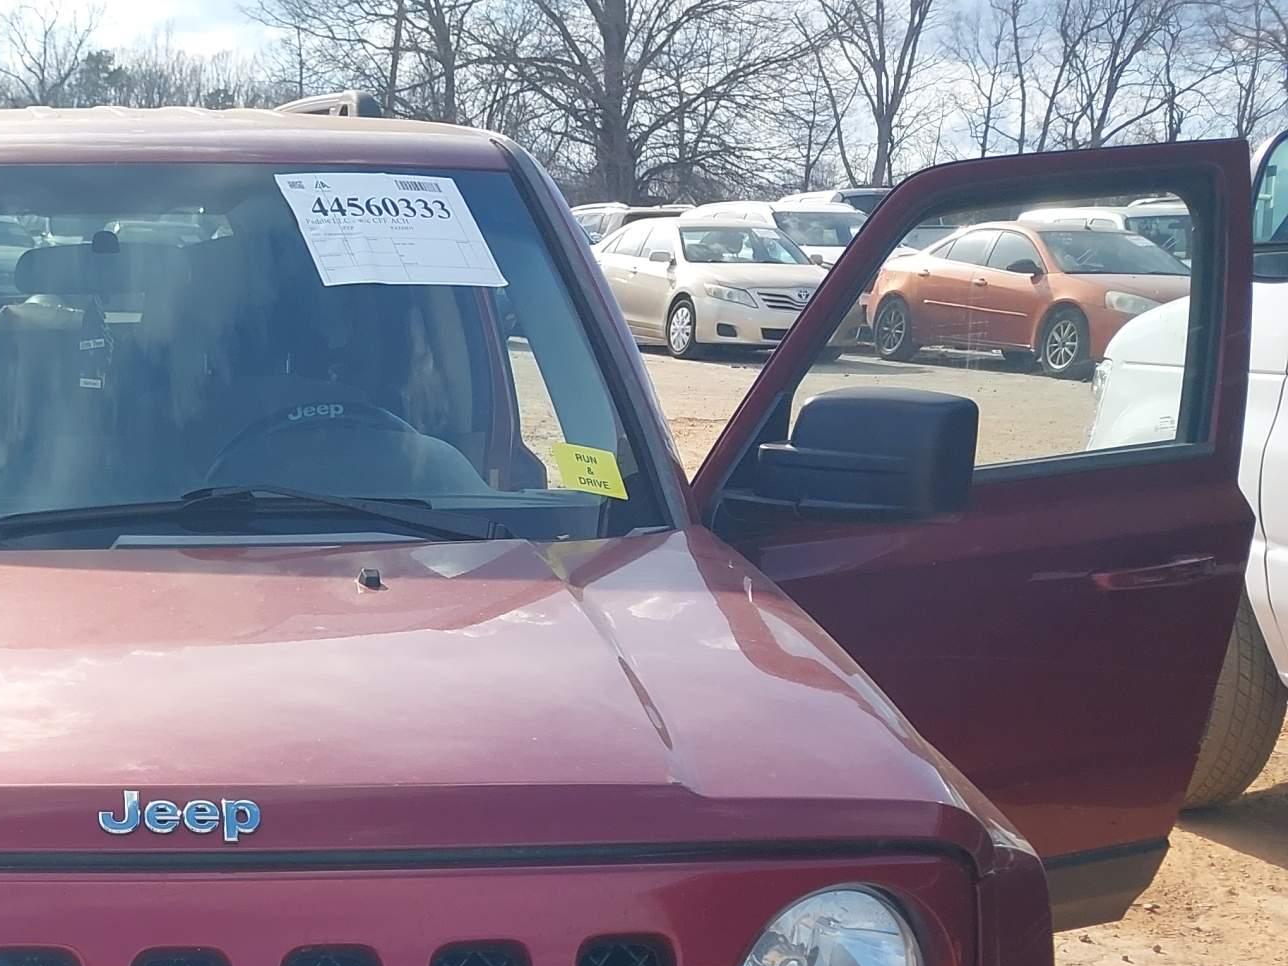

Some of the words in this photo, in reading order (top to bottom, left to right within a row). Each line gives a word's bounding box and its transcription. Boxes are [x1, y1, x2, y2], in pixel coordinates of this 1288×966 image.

[311, 196, 451, 219] 44560333
[288, 404, 344, 420] Jeep
[574, 453, 598, 465] RUN
[586, 466, 595, 476] &
[578, 476, 612, 490] DRIVE
[98, 790, 261, 842] Jeep
